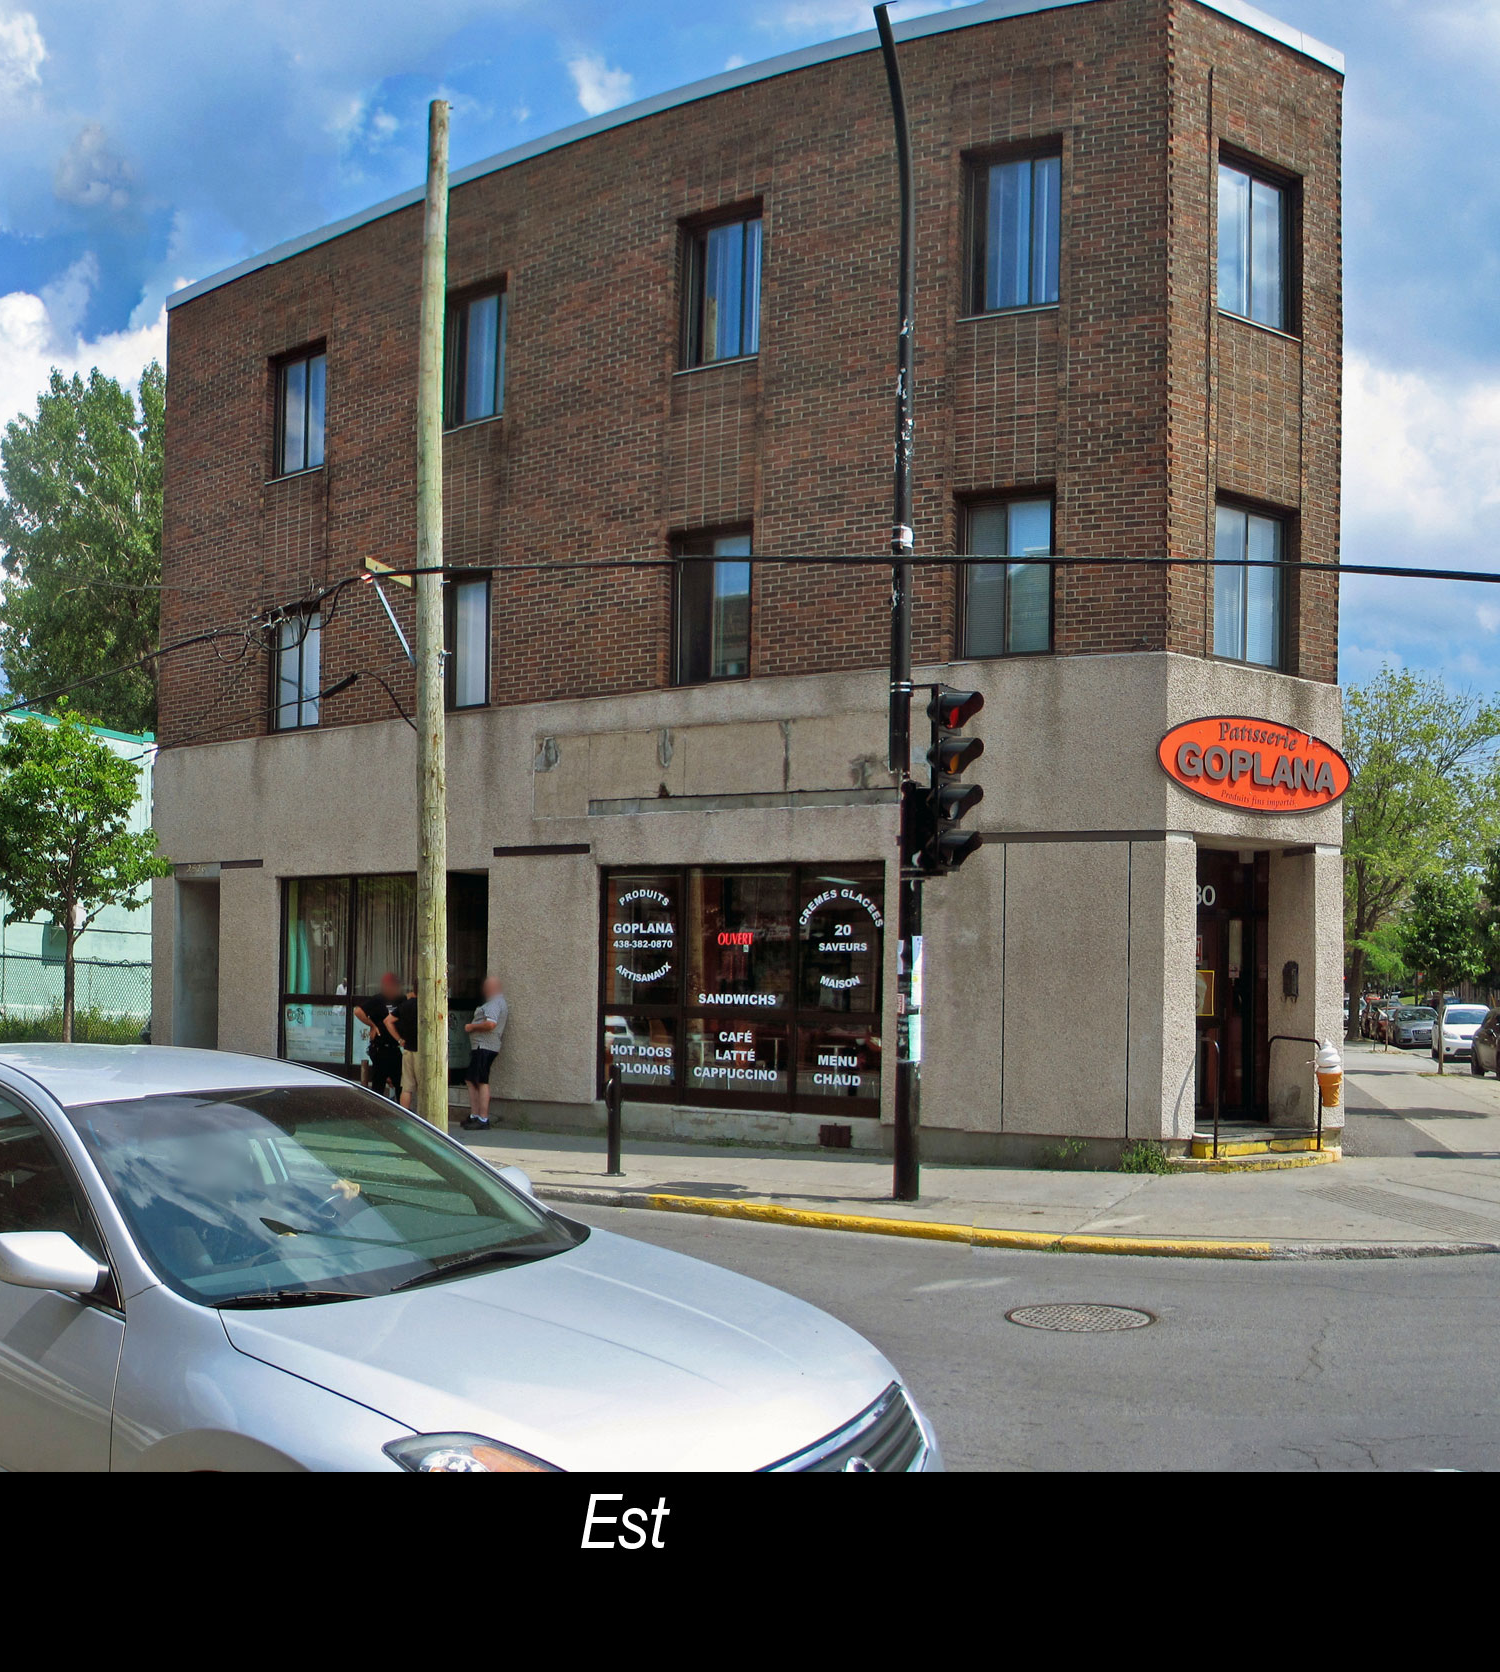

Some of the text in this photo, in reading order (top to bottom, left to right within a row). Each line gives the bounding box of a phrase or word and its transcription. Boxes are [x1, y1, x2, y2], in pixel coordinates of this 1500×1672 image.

[1177, 741, 1336, 795] GOPLANA
[1220, 789, 1250, 803] Produits
[1250, 796, 1265, 807] fins
[619, 889, 670, 906] PRODUITS
[798, 888, 884, 928] CREMES GLACEES
[613, 922, 674, 935] GOPLANA
[834, 924, 852, 937] 20
[613, 939, 673, 949] 438-382-0870
[717, 932, 754, 946] OUVERT
[818, 942, 868, 952] SAVEURS
[615, 961, 672, 983] ARTISANAUX
[819, 975, 861, 989] MAISON
[698, 993, 776, 1006] SANDWICHS
[718, 1030, 753, 1043] CAFÉ
[610, 1044, 672, 1059] HOT DOGS
[715, 1048, 756, 1062] LATTÉ
[817, 1054, 858, 1068] MENU
[616, 1062, 671, 1076] OLONAIS
[693, 1065, 778, 1082] CAPPUCCINO
[813, 1073, 861, 1087] CHAUD
